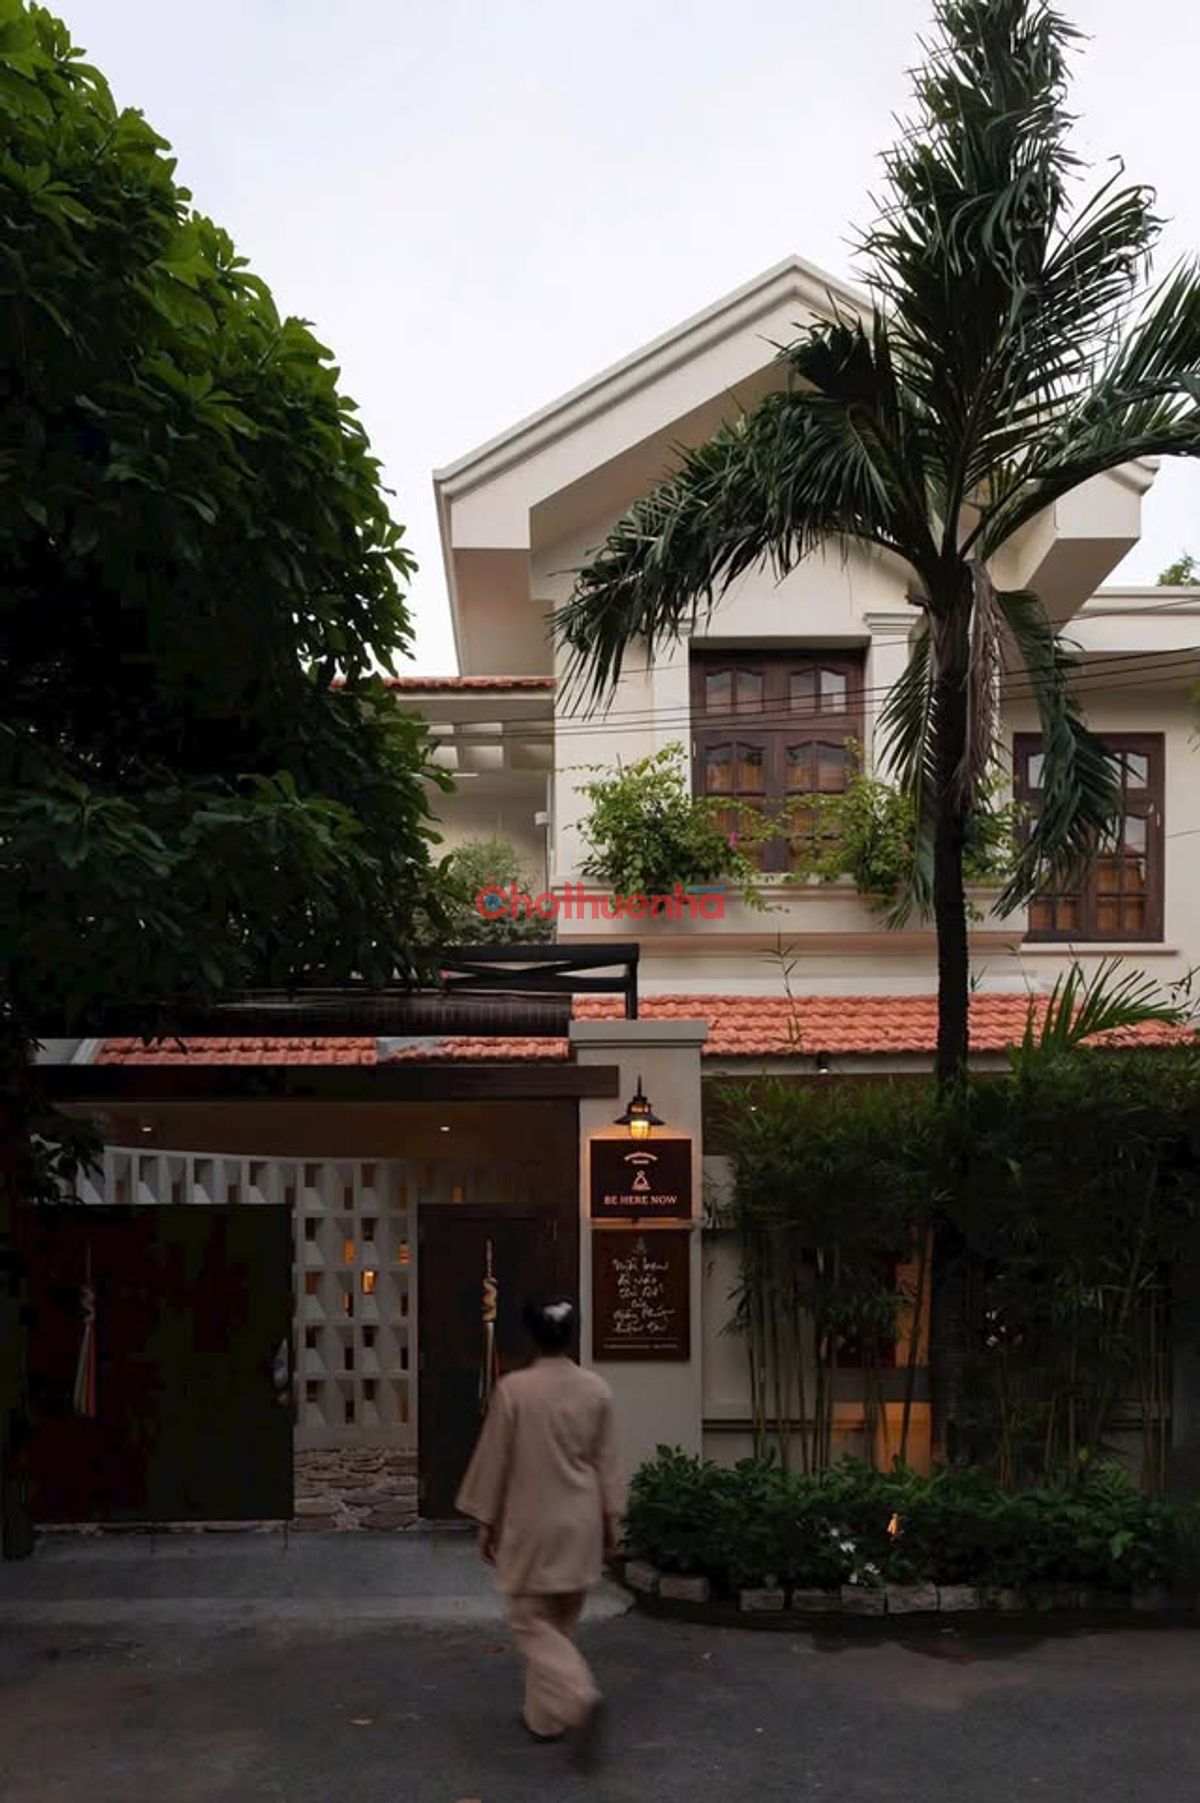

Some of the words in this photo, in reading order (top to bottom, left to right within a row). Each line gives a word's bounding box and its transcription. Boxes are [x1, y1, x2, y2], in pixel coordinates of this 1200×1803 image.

[604, 1195, 618, 1205] BE
[620, 1195, 649, 1205] HERE
[650, 1195, 678, 1205] NOW
